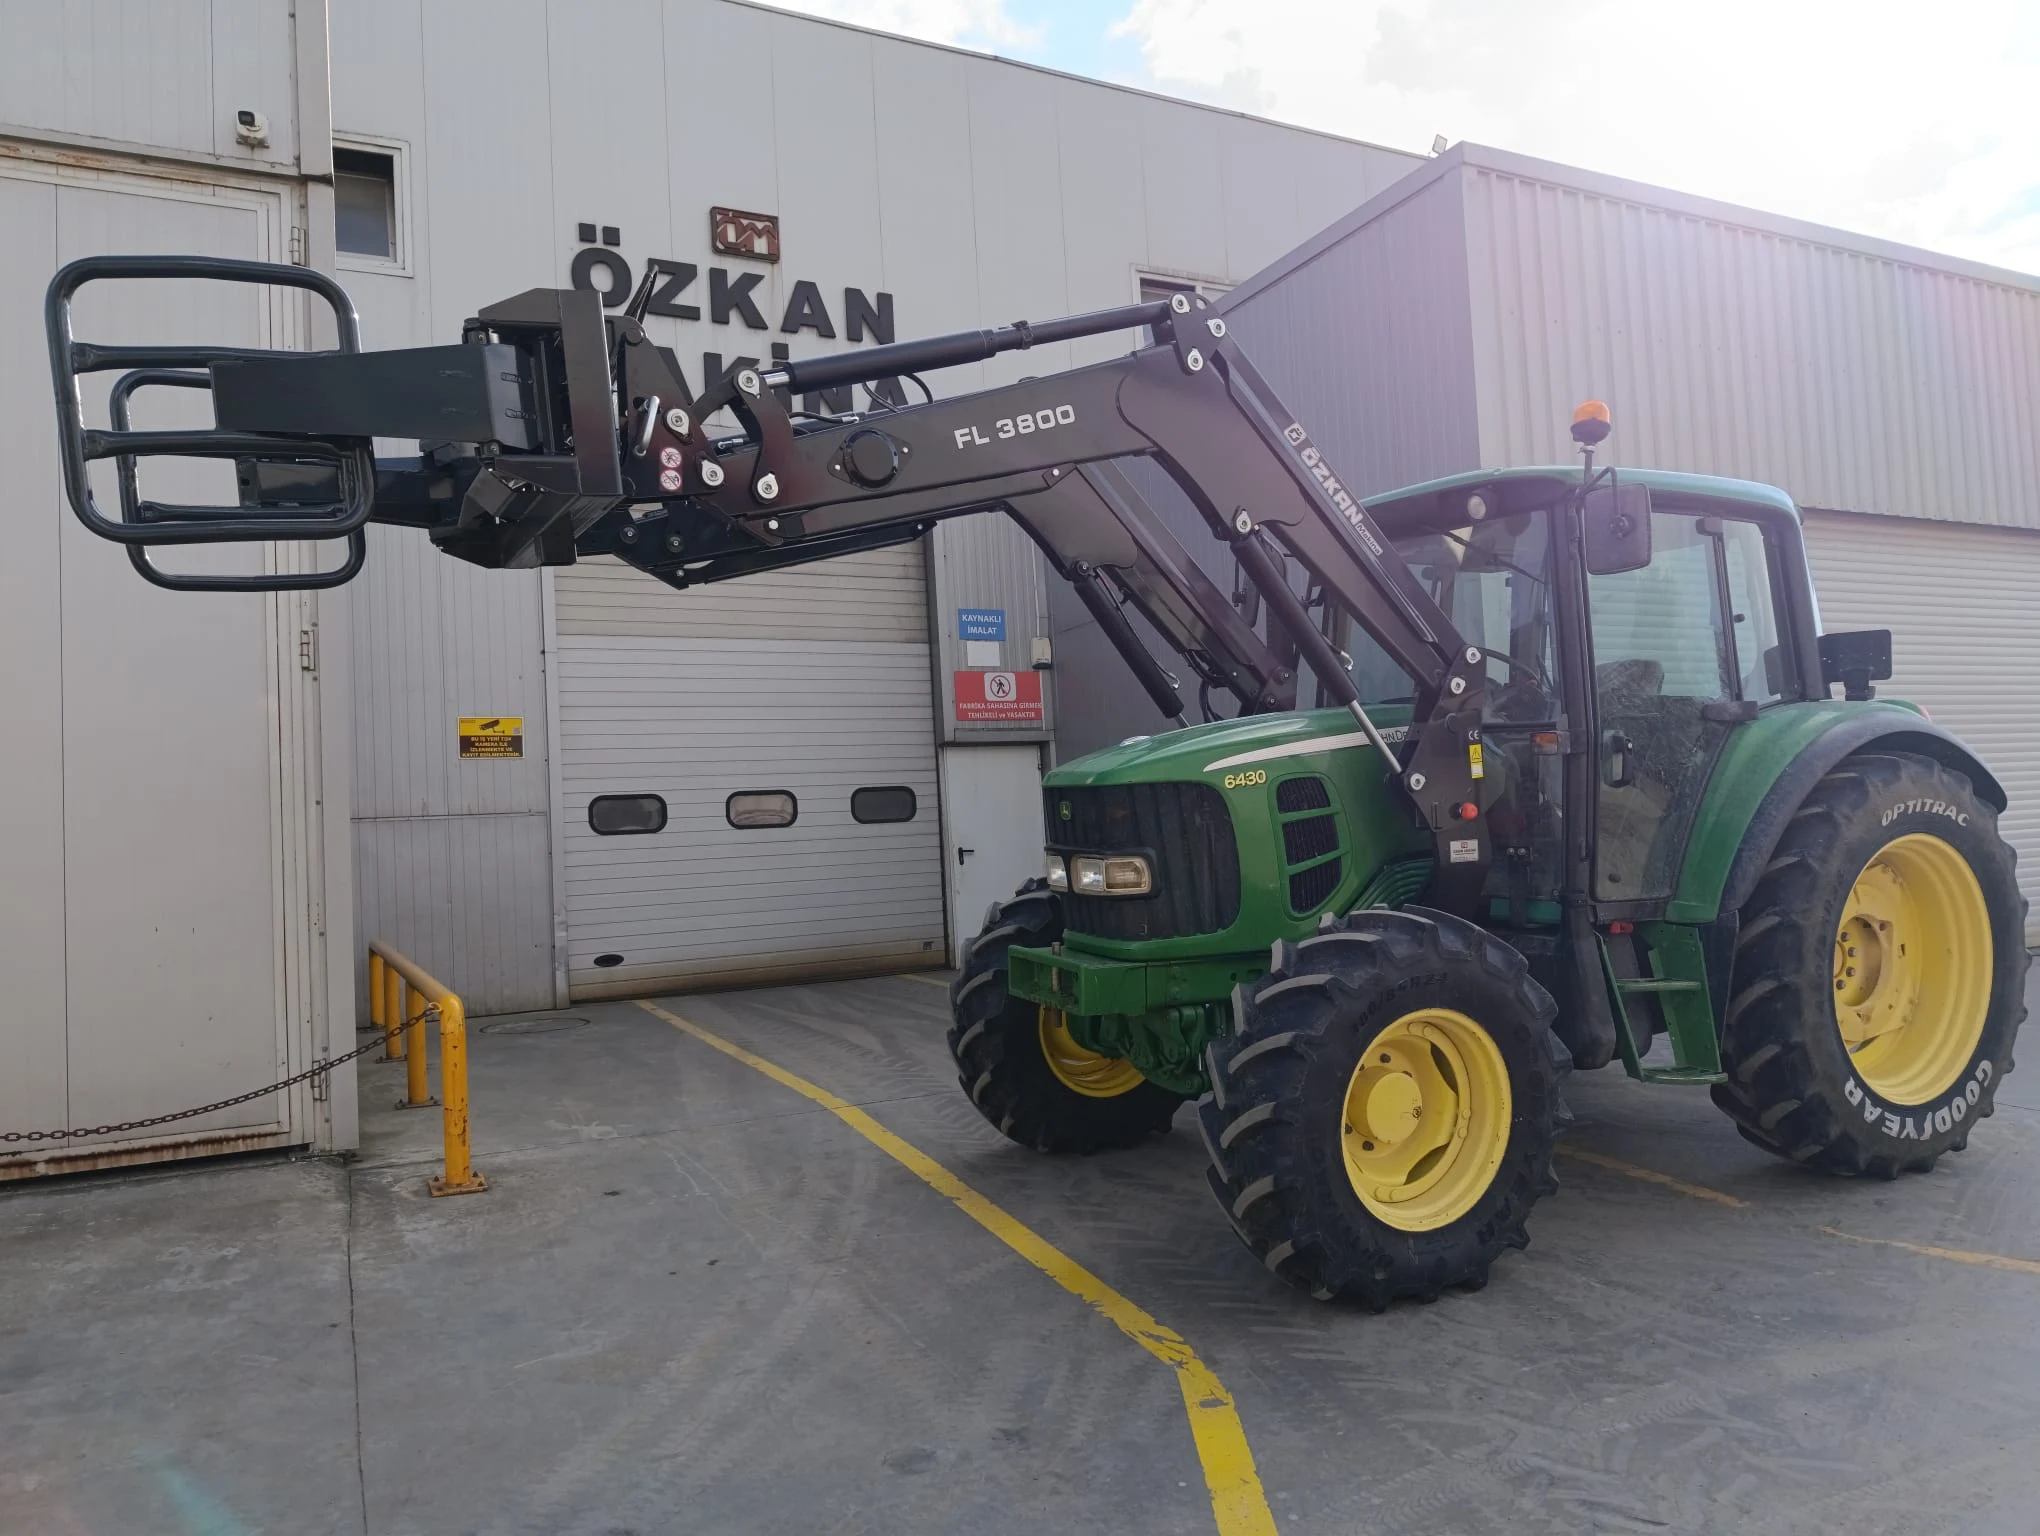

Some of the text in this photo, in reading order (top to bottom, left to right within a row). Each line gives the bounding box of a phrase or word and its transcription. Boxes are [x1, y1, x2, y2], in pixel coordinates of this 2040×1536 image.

[571, 222, 896, 345] ÖZKAN
[953, 404, 1076, 450] FL 3800
[961, 614, 1002, 623] KAYNAKLI
[967, 625, 998, 635] İMALAT
[1468, 729, 1480, 741] CE
[1224, 769, 1267, 789] 6430
[1881, 798, 1970, 828] OPTITRAC
[1844, 1059, 1993, 1141] GOODYEAR
